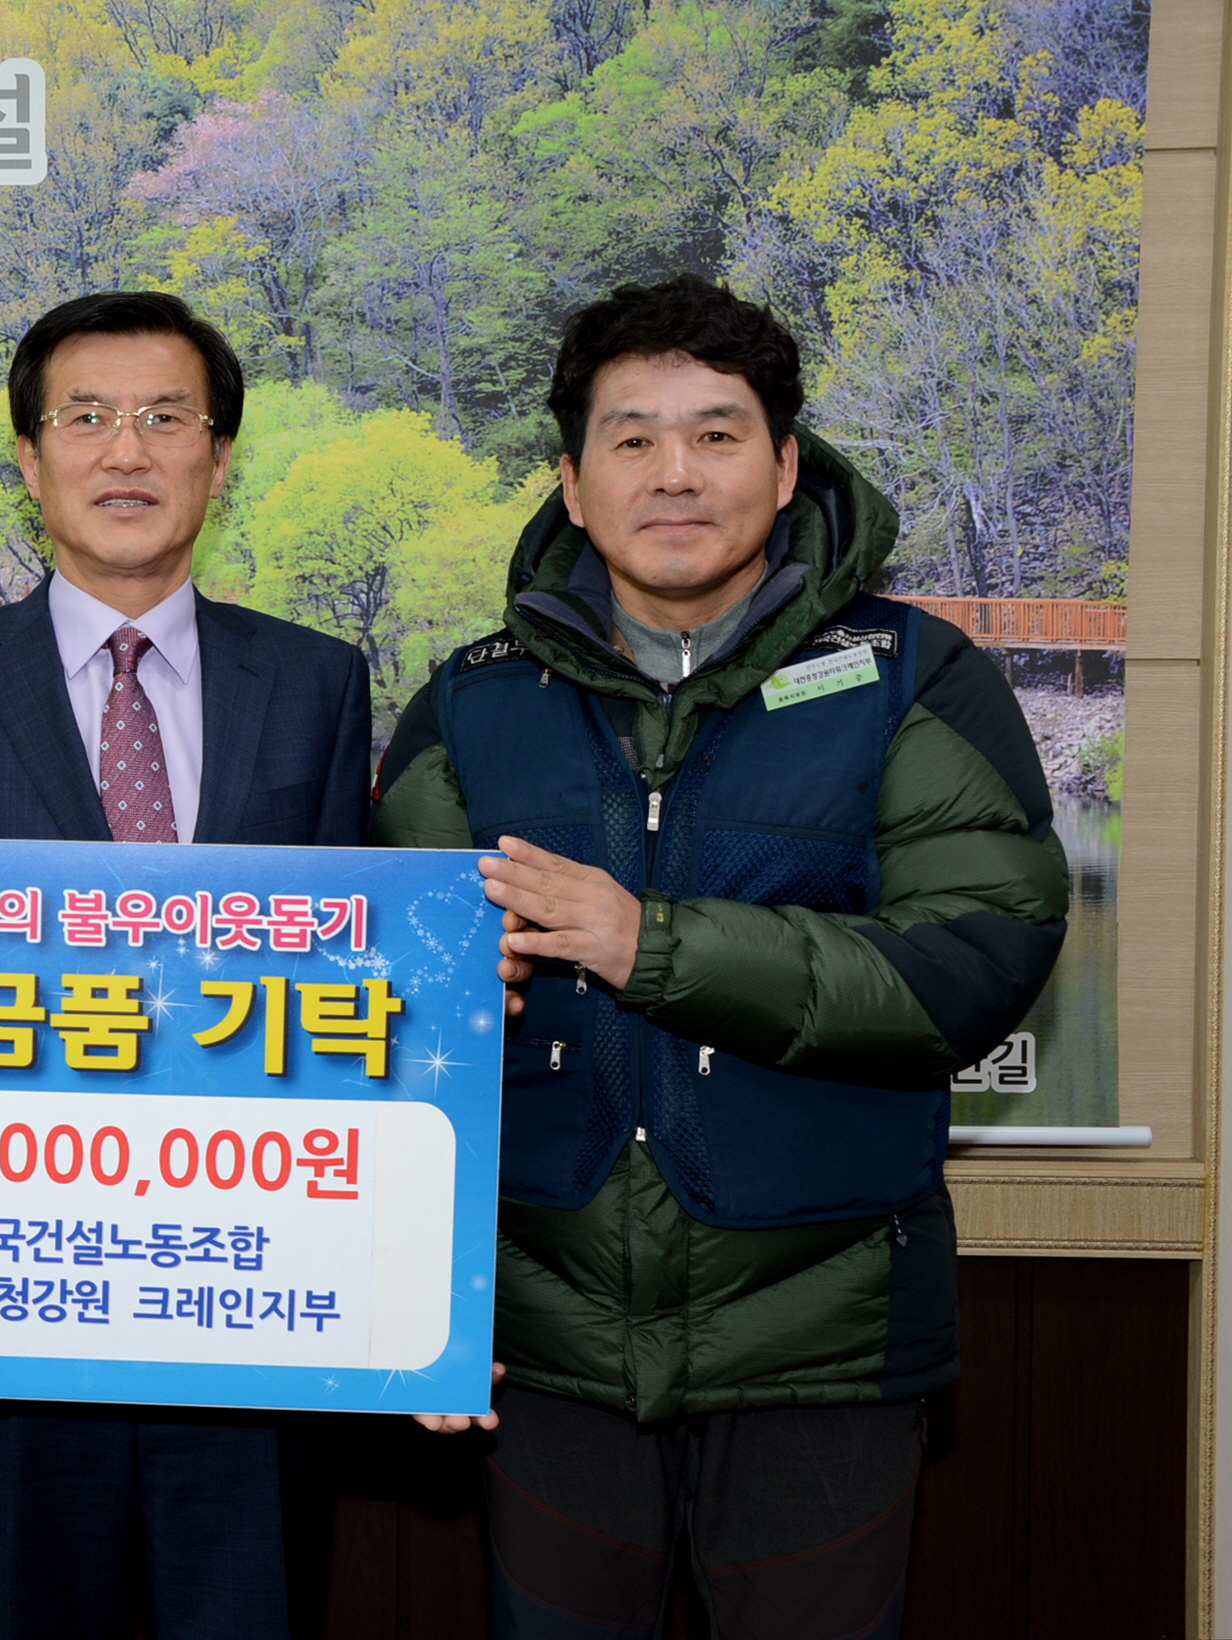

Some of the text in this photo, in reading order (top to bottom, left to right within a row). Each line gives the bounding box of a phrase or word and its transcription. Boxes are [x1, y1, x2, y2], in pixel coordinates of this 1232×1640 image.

[62, 892, 367, 950] 불우이웃돕기
[193, 974, 403, 1077] 기탁
[133, 1284, 341, 1333] 크레인지부
